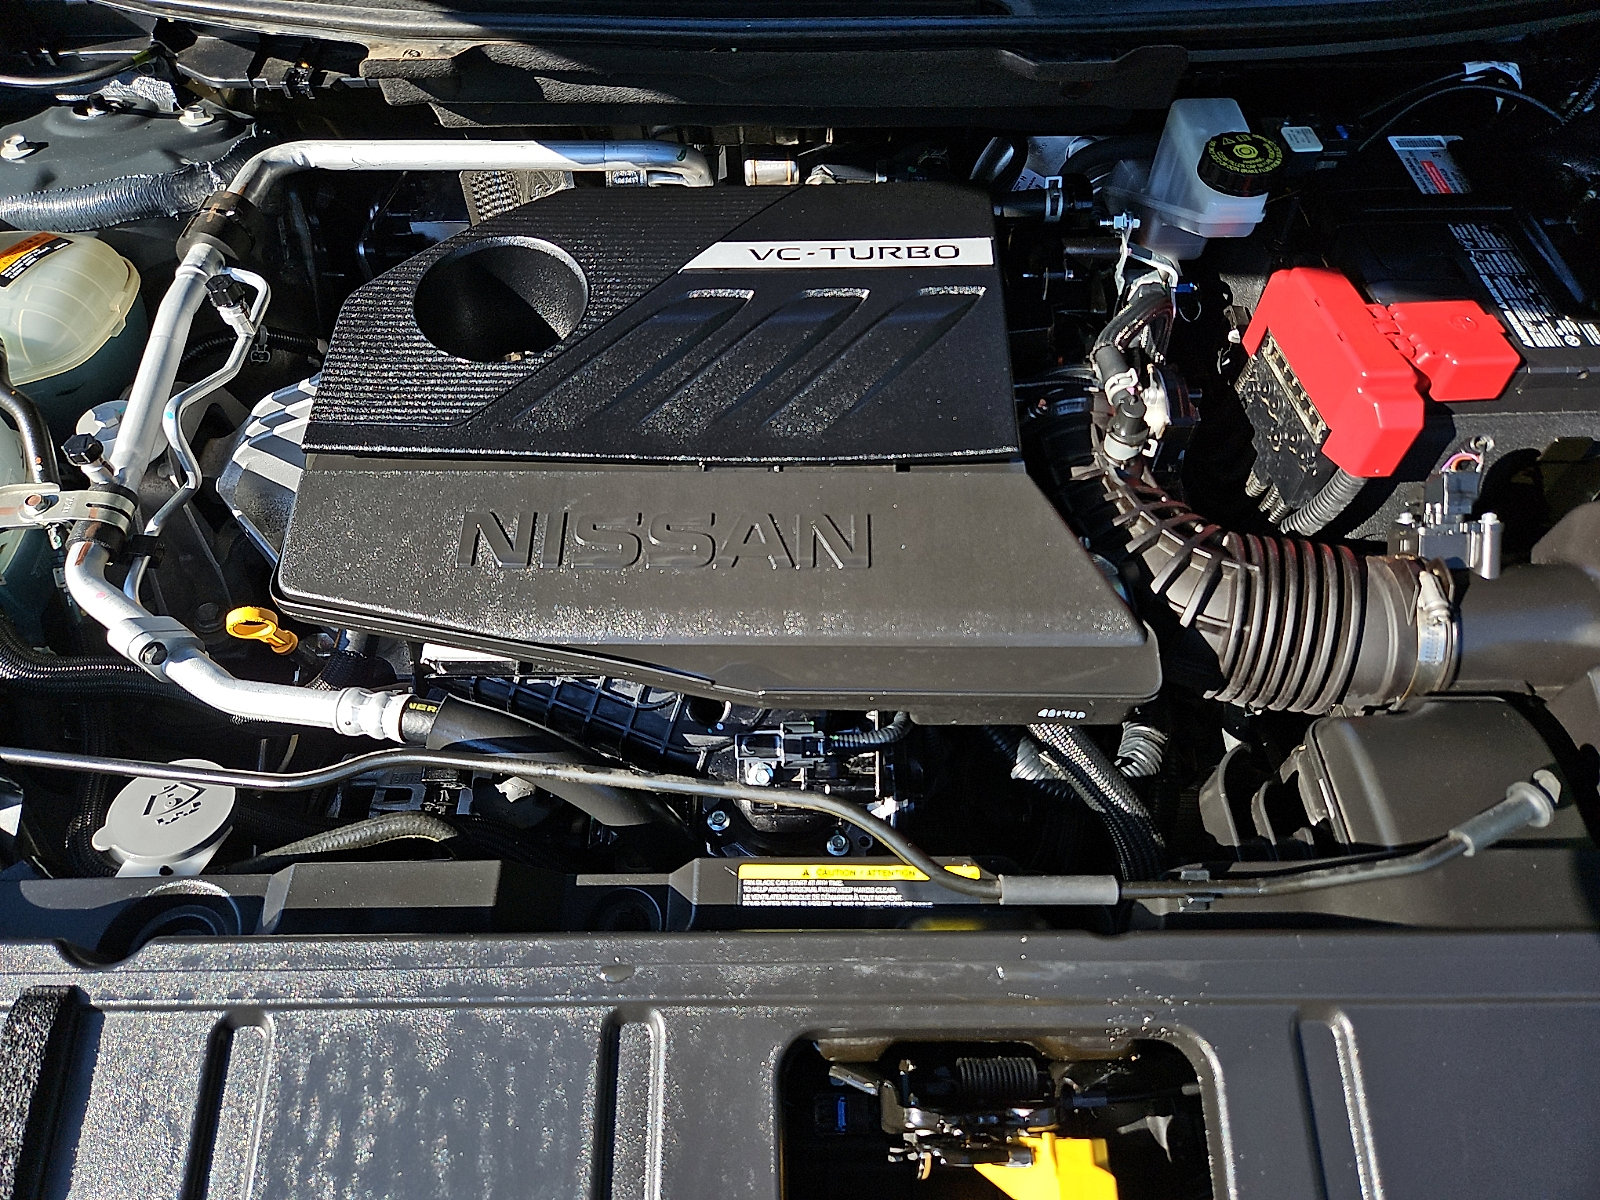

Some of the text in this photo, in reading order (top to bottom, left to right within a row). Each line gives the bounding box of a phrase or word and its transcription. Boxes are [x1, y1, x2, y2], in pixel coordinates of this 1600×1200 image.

[749, 244, 960, 261] VC-TURBO
[457, 511, 873, 569] NISSAN
[867, 869, 917, 877] ATTENTION
